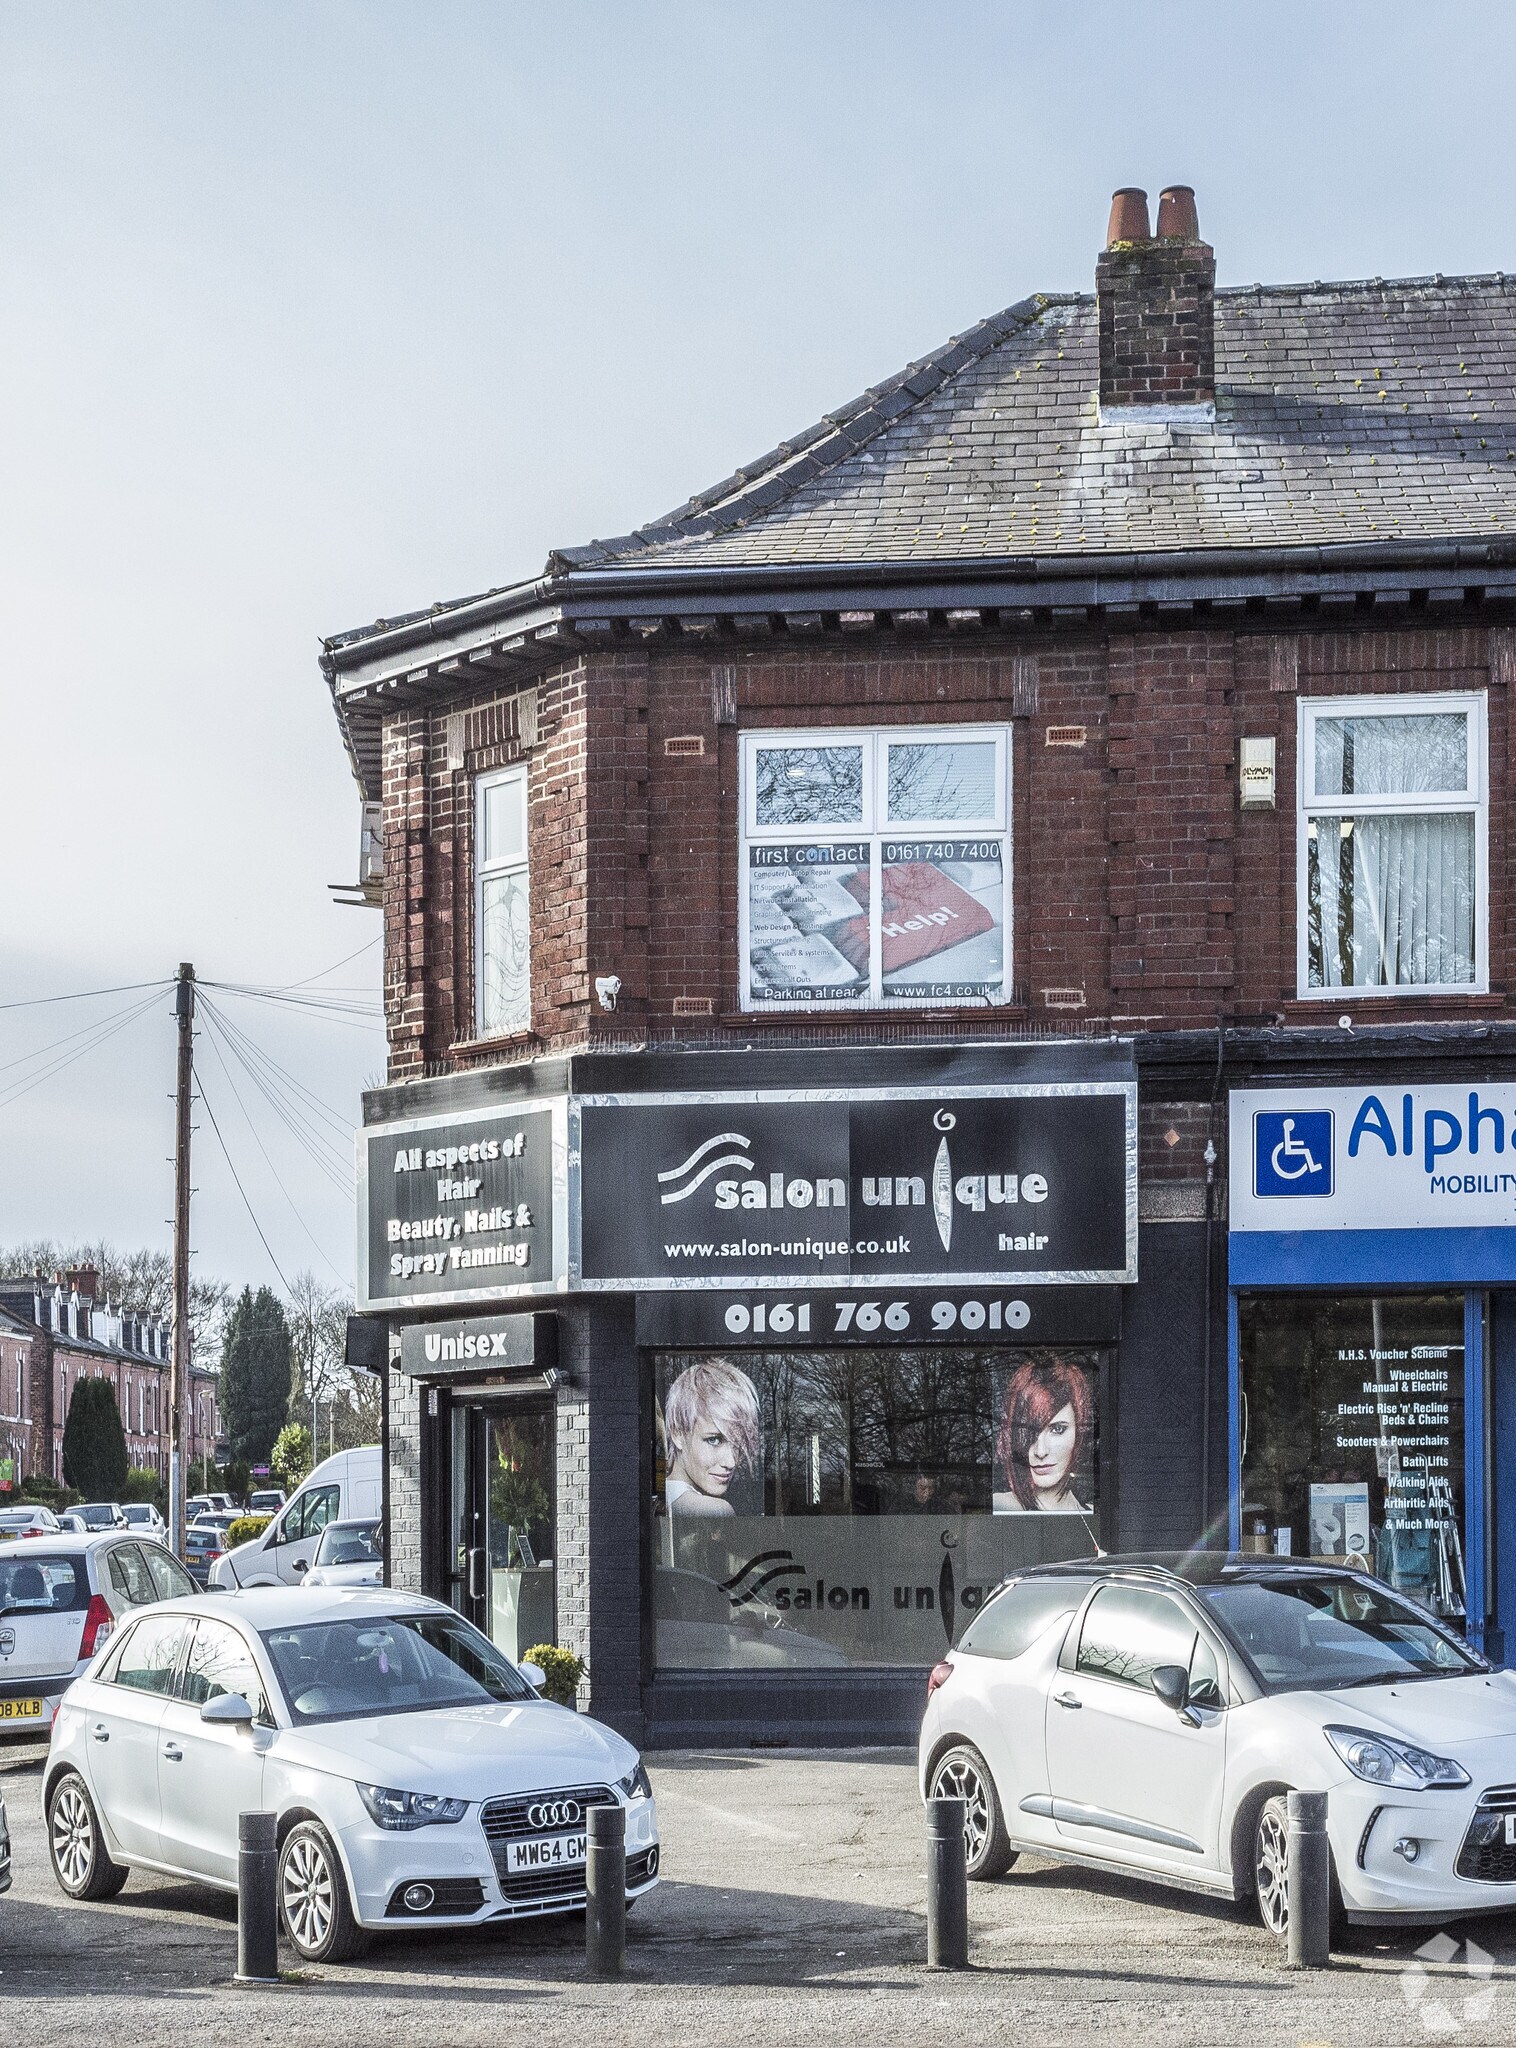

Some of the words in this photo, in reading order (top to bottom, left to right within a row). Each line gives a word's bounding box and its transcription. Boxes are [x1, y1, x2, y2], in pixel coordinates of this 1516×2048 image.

[755, 846, 790, 864] first
[795, 844, 865, 863] contact
[887, 844, 920, 860] 0161
[924, 843, 954, 859] 740
[960, 842, 999, 858] 7400
[811, 868, 832, 876] Repair
[760, 883, 785, 892] Support
[770, 924, 791, 932] Design
[881, 906, 959, 938] Help!
[771, 949, 797, 957] Services
[805, 949, 830, 957] systems
[764, 987, 812, 1000] Parking
[815, 986, 828, 999] at
[893, 984, 991, 996] www.fc4.co.uk
[1347, 1091, 1516, 1174] Alph
[394, 1147, 422, 1173] All
[425, 1138, 499, 1170] aspects
[502, 1132, 526, 1158] of
[437, 1175, 482, 1202] Hair
[714, 1172, 846, 1210] salon
[387, 1213, 463, 1241] Beauty,
[464, 1206, 513, 1233] Nails
[515, 1203, 532, 1227] &
[664, 1235, 911, 1260] www.salon-unique.co.uk
[998, 1232, 1049, 1251] hair
[390, 1251, 447, 1278] Spray
[449, 1241, 529, 1270] Tanning
[724, 1302, 810, 1333] 0161
[834, 1301, 910, 1331] 766
[931, 1299, 1031, 1330] 9010
[424, 1330, 508, 1362] Unisex
[1338, 1349, 1367, 1361] N.H.S.
[1370, 1348, 1409, 1360] Voucher
[1411, 1348, 1448, 1359] Scheme
[1389, 1369, 1449, 1381] Wheelchairs
[1362, 1382, 1399, 1393] Manual
[1401, 1381, 1409, 1392] &
[1411, 1380, 1448, 1392] Electric
[1338, 1403, 1374, 1414] Electric
[1377, 1403, 1397, 1414] Rise
[1399, 1403, 1411, 1414] 'n'
[1413, 1402, 1449, 1414] Recline
[1382, 1414, 1405, 1426] Beds
[1408, 1414, 1416, 1425] &
[1418, 1413, 1449, 1425] Chairs
[1336, 1436, 1378, 1448] Scooters
[1380, 1435, 1388, 1447] &
[1390, 1434, 1449, 1446] Powerchairs
[1402, 1456, 1425, 1467] Bath
[1427, 1455, 1449, 1467] Lifts
[1388, 1476, 1426, 1489] Walking
[1428, 1476, 1449, 1487] Aids
[1383, 1497, 1426, 1509] Arthiritic
[1428, 1497, 1449, 1508] Aids
[1385, 1518, 1393, 1530] &
[1396, 1518, 1422, 1530] Much
[1425, 1518, 1449, 1529] More
[774, 1579, 870, 1611] salon
[16, 1701, 40, 1716] XLB
[516, 1840, 562, 1867] MW64
[566, 1836, 587, 1859] GM
